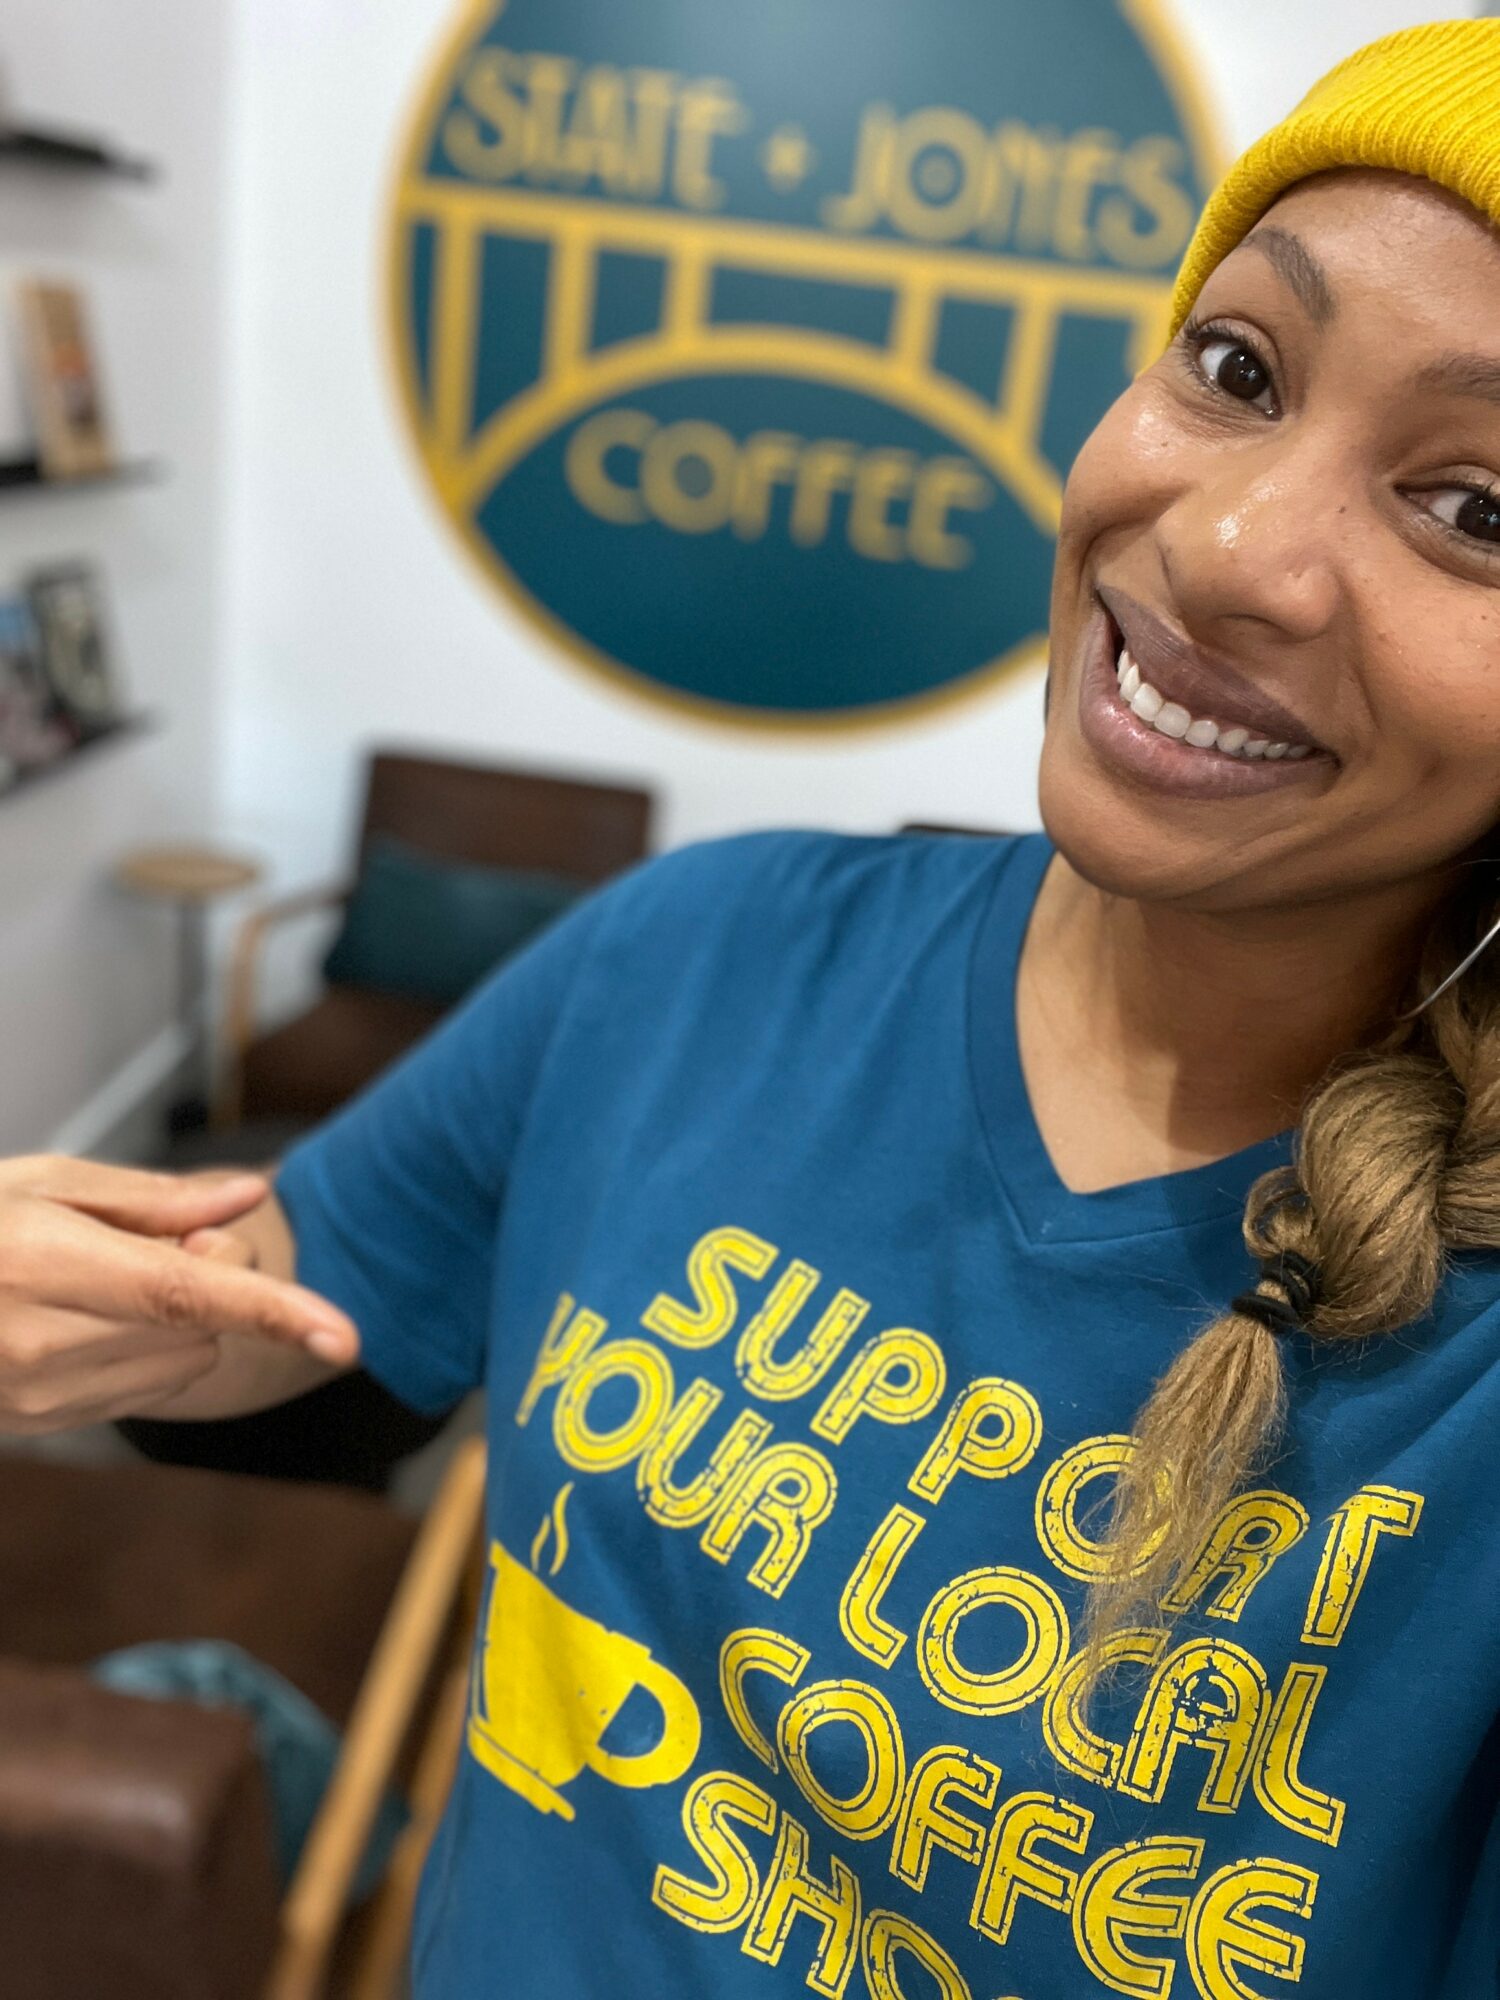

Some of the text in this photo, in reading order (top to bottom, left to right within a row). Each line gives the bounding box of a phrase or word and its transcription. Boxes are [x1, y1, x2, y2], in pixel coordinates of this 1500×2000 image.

[443, 47, 1195, 269] STATE JONES
[566, 409, 992, 569] COFFEE
[516, 1292, 1345, 1846] YOUR LOCAL
[641, 1226, 1424, 1646] SUPPORT
[652, 1771, 1033, 2000] SHO
[720, 1628, 1319, 2000] COFFEE
